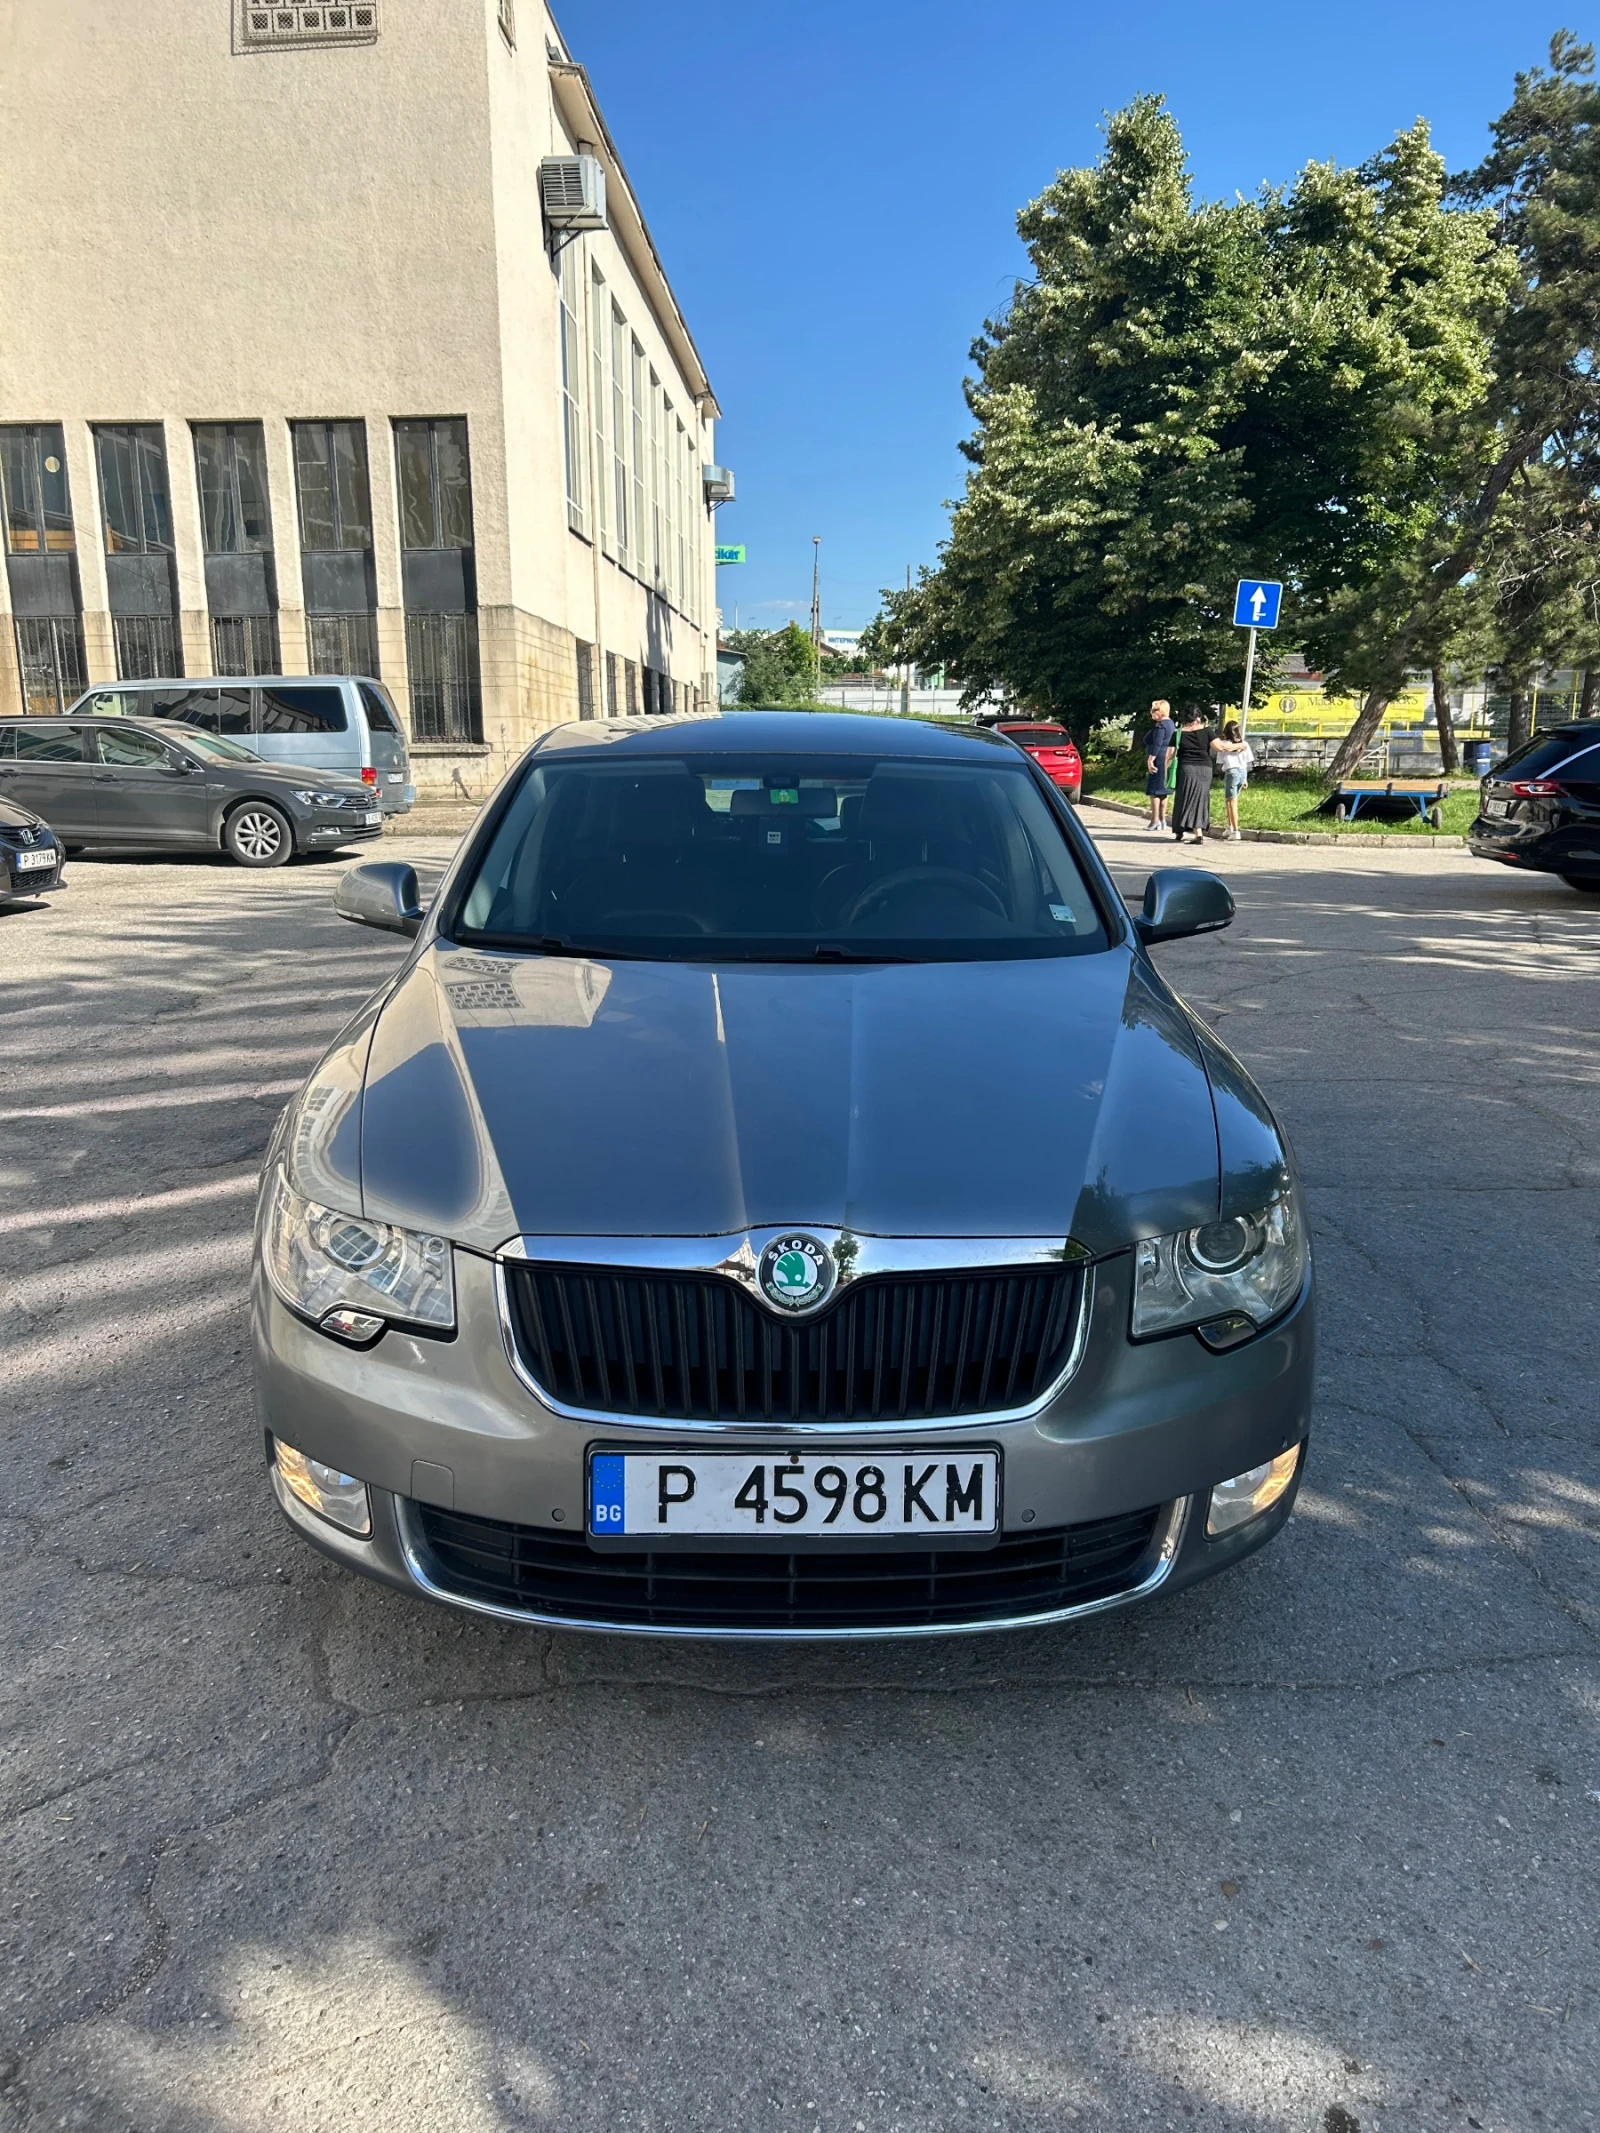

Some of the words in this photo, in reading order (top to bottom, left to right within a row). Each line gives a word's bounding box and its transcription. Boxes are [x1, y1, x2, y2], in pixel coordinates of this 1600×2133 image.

[768, 1239, 824, 1266] SKODA
[595, 1503, 622, 1522] BG
[658, 1464, 696, 1524] P
[734, 1464, 888, 1524] 4598
[903, 1463, 983, 1523] KM
